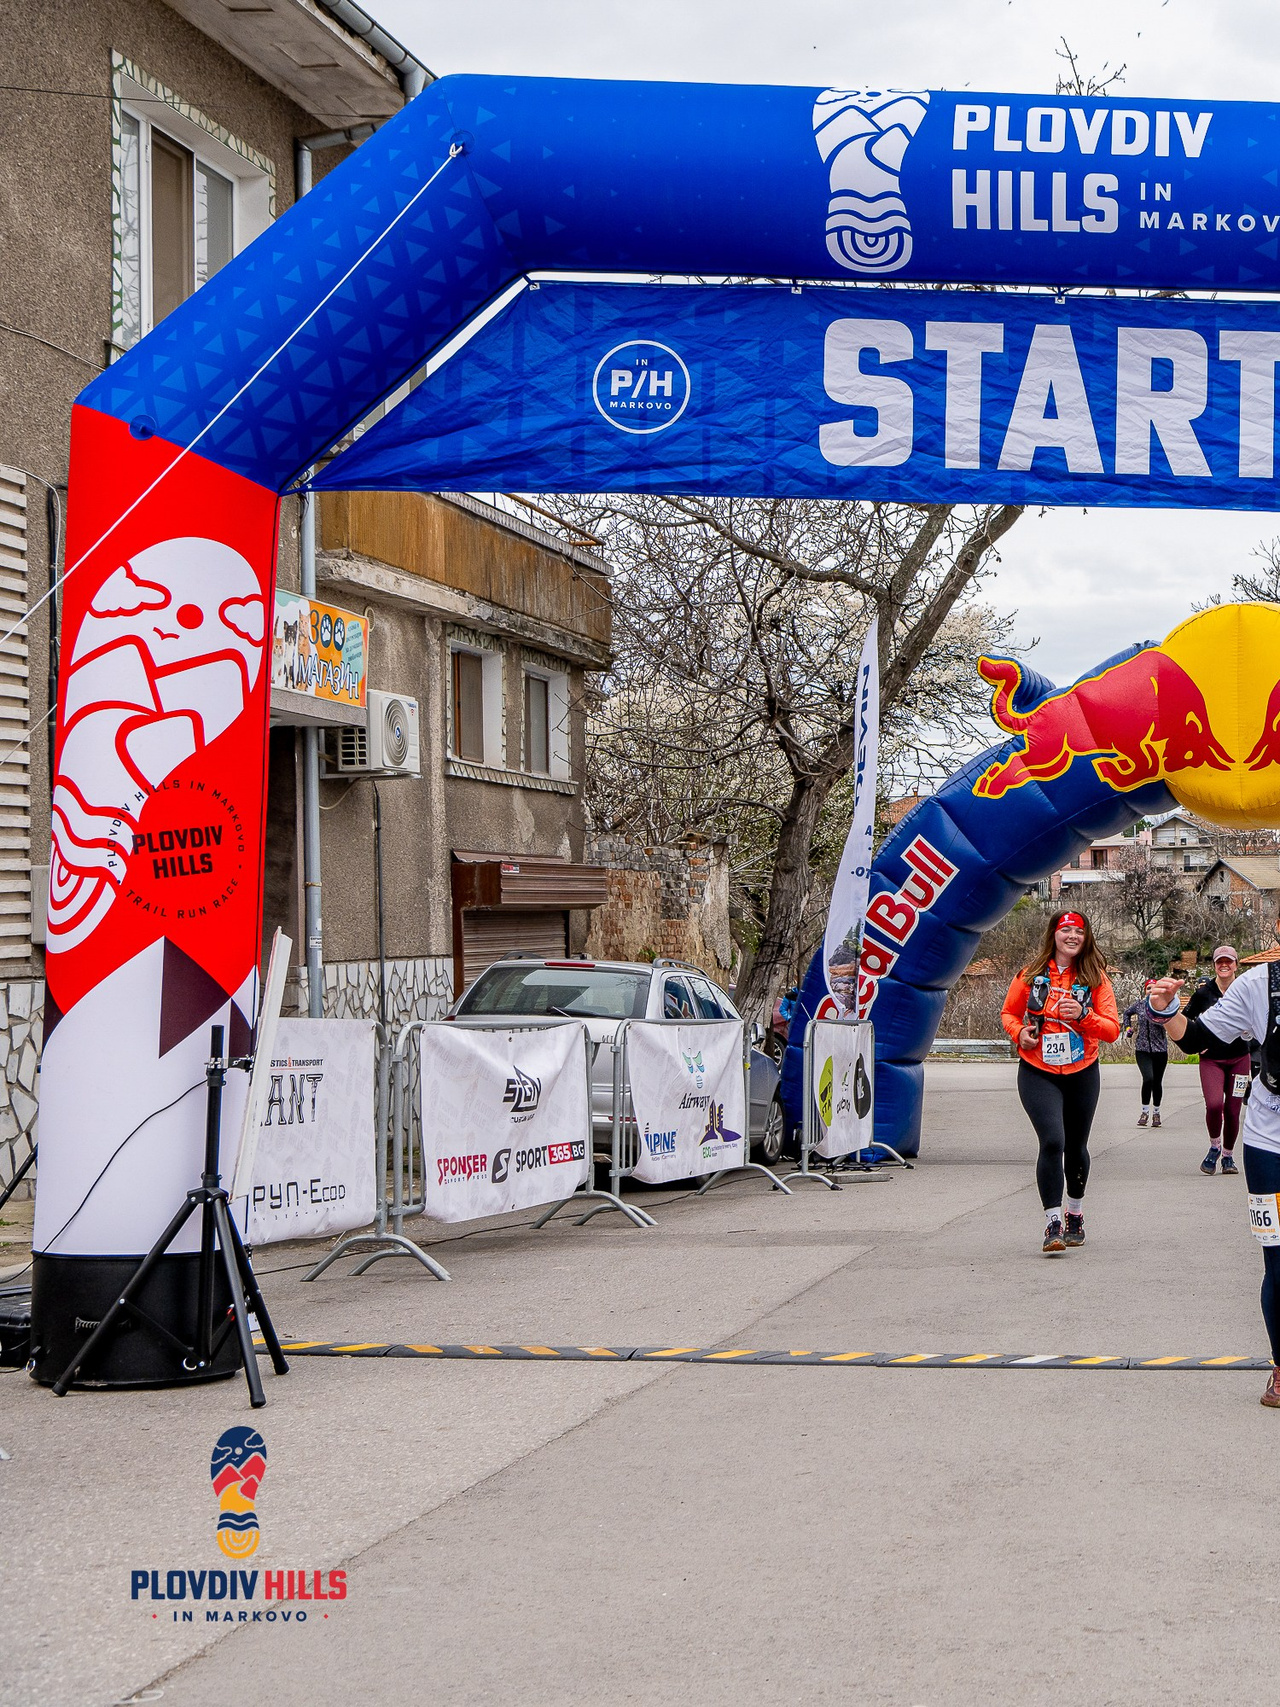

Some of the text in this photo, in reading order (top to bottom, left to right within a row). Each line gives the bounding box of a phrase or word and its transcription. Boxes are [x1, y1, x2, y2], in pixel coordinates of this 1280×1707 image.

[952, 104, 1213, 158] PLOVDIV
[952, 168, 1119, 234] HILLS
[1140, 182, 1172, 202] IN
[611, 369, 673, 399] P/H
[610, 401, 672, 410] MARKOVO
[297, 653, 359, 699] МАГАЗИН
[134, 779, 245, 852] HILLS IN MARKOVO
[107, 803, 131, 868] PLOVDIV
[131, 825, 223, 855] PLOVDIV
[152, 853, 213, 880] HILLS
[126, 878, 238, 919] TRAIL RUN RACE
[866, 838, 954, 942] Bull
[292, 1059, 324, 1067] TRANSPORT
[1047, 1043, 1065, 1054] 234
[437, 1153, 487, 1186] SPONSER
[1250, 1209, 1272, 1227] 1166
